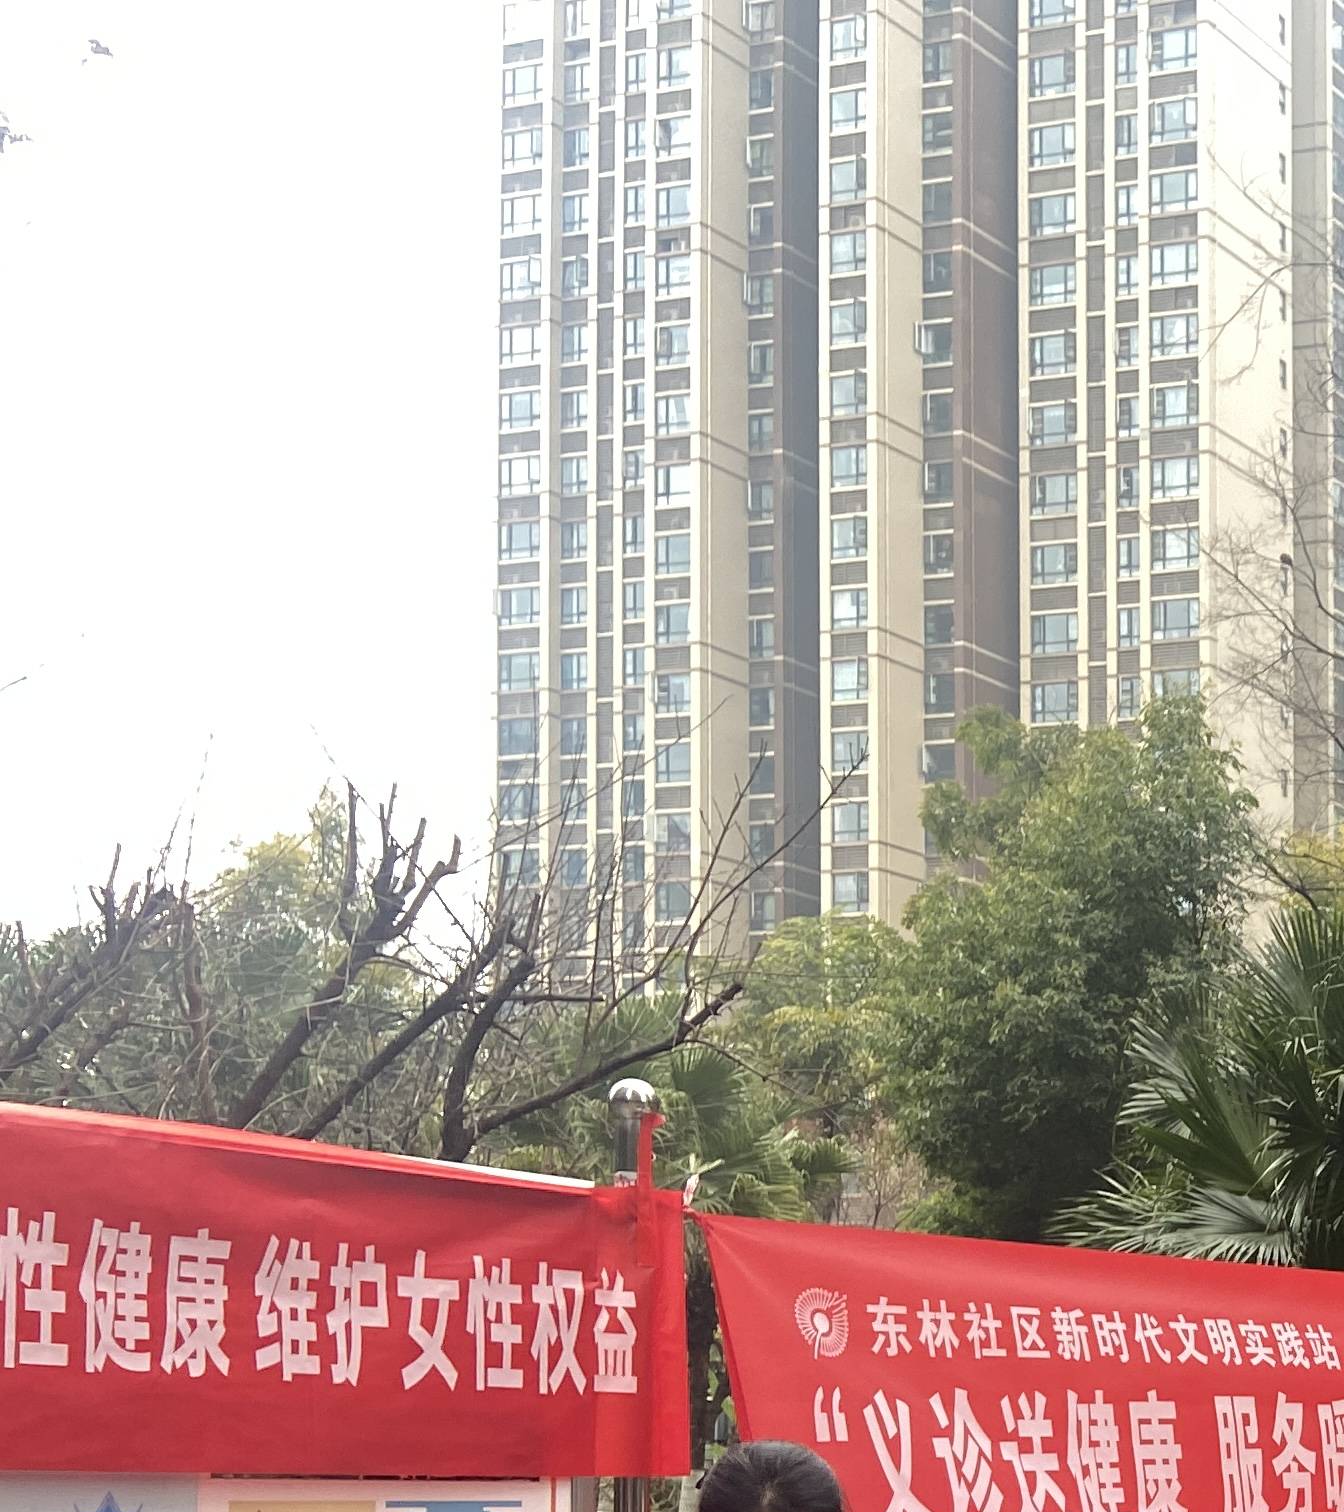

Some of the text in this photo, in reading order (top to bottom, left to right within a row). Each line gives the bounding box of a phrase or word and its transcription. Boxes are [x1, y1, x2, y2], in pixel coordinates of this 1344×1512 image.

[0, 1208, 638, 1394] 性健康 维护女性权益
[866, 1296, 1341, 1370] 东林社区新时代文明实践站
